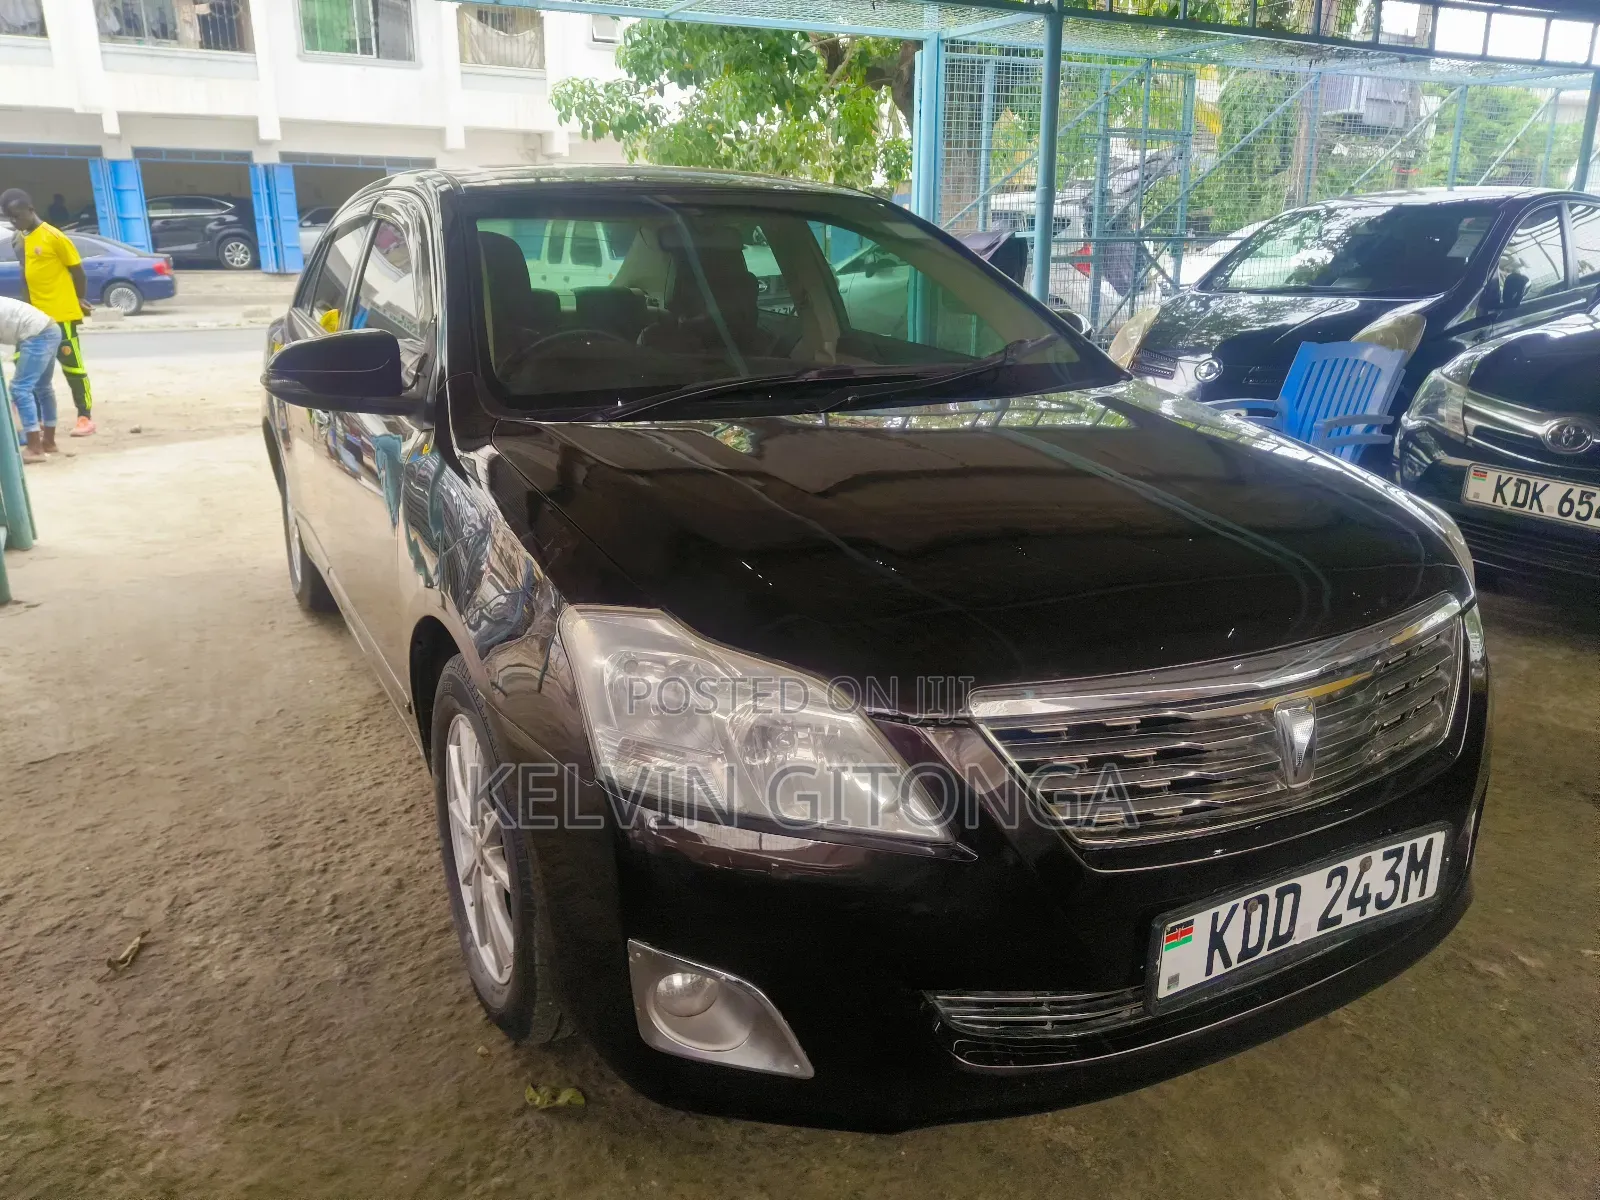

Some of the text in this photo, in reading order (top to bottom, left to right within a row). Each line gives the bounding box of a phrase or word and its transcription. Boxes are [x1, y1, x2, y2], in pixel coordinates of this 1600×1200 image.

[1491, 474, 1550, 514] KDK
[1204, 837, 1435, 977] KDD 243M
